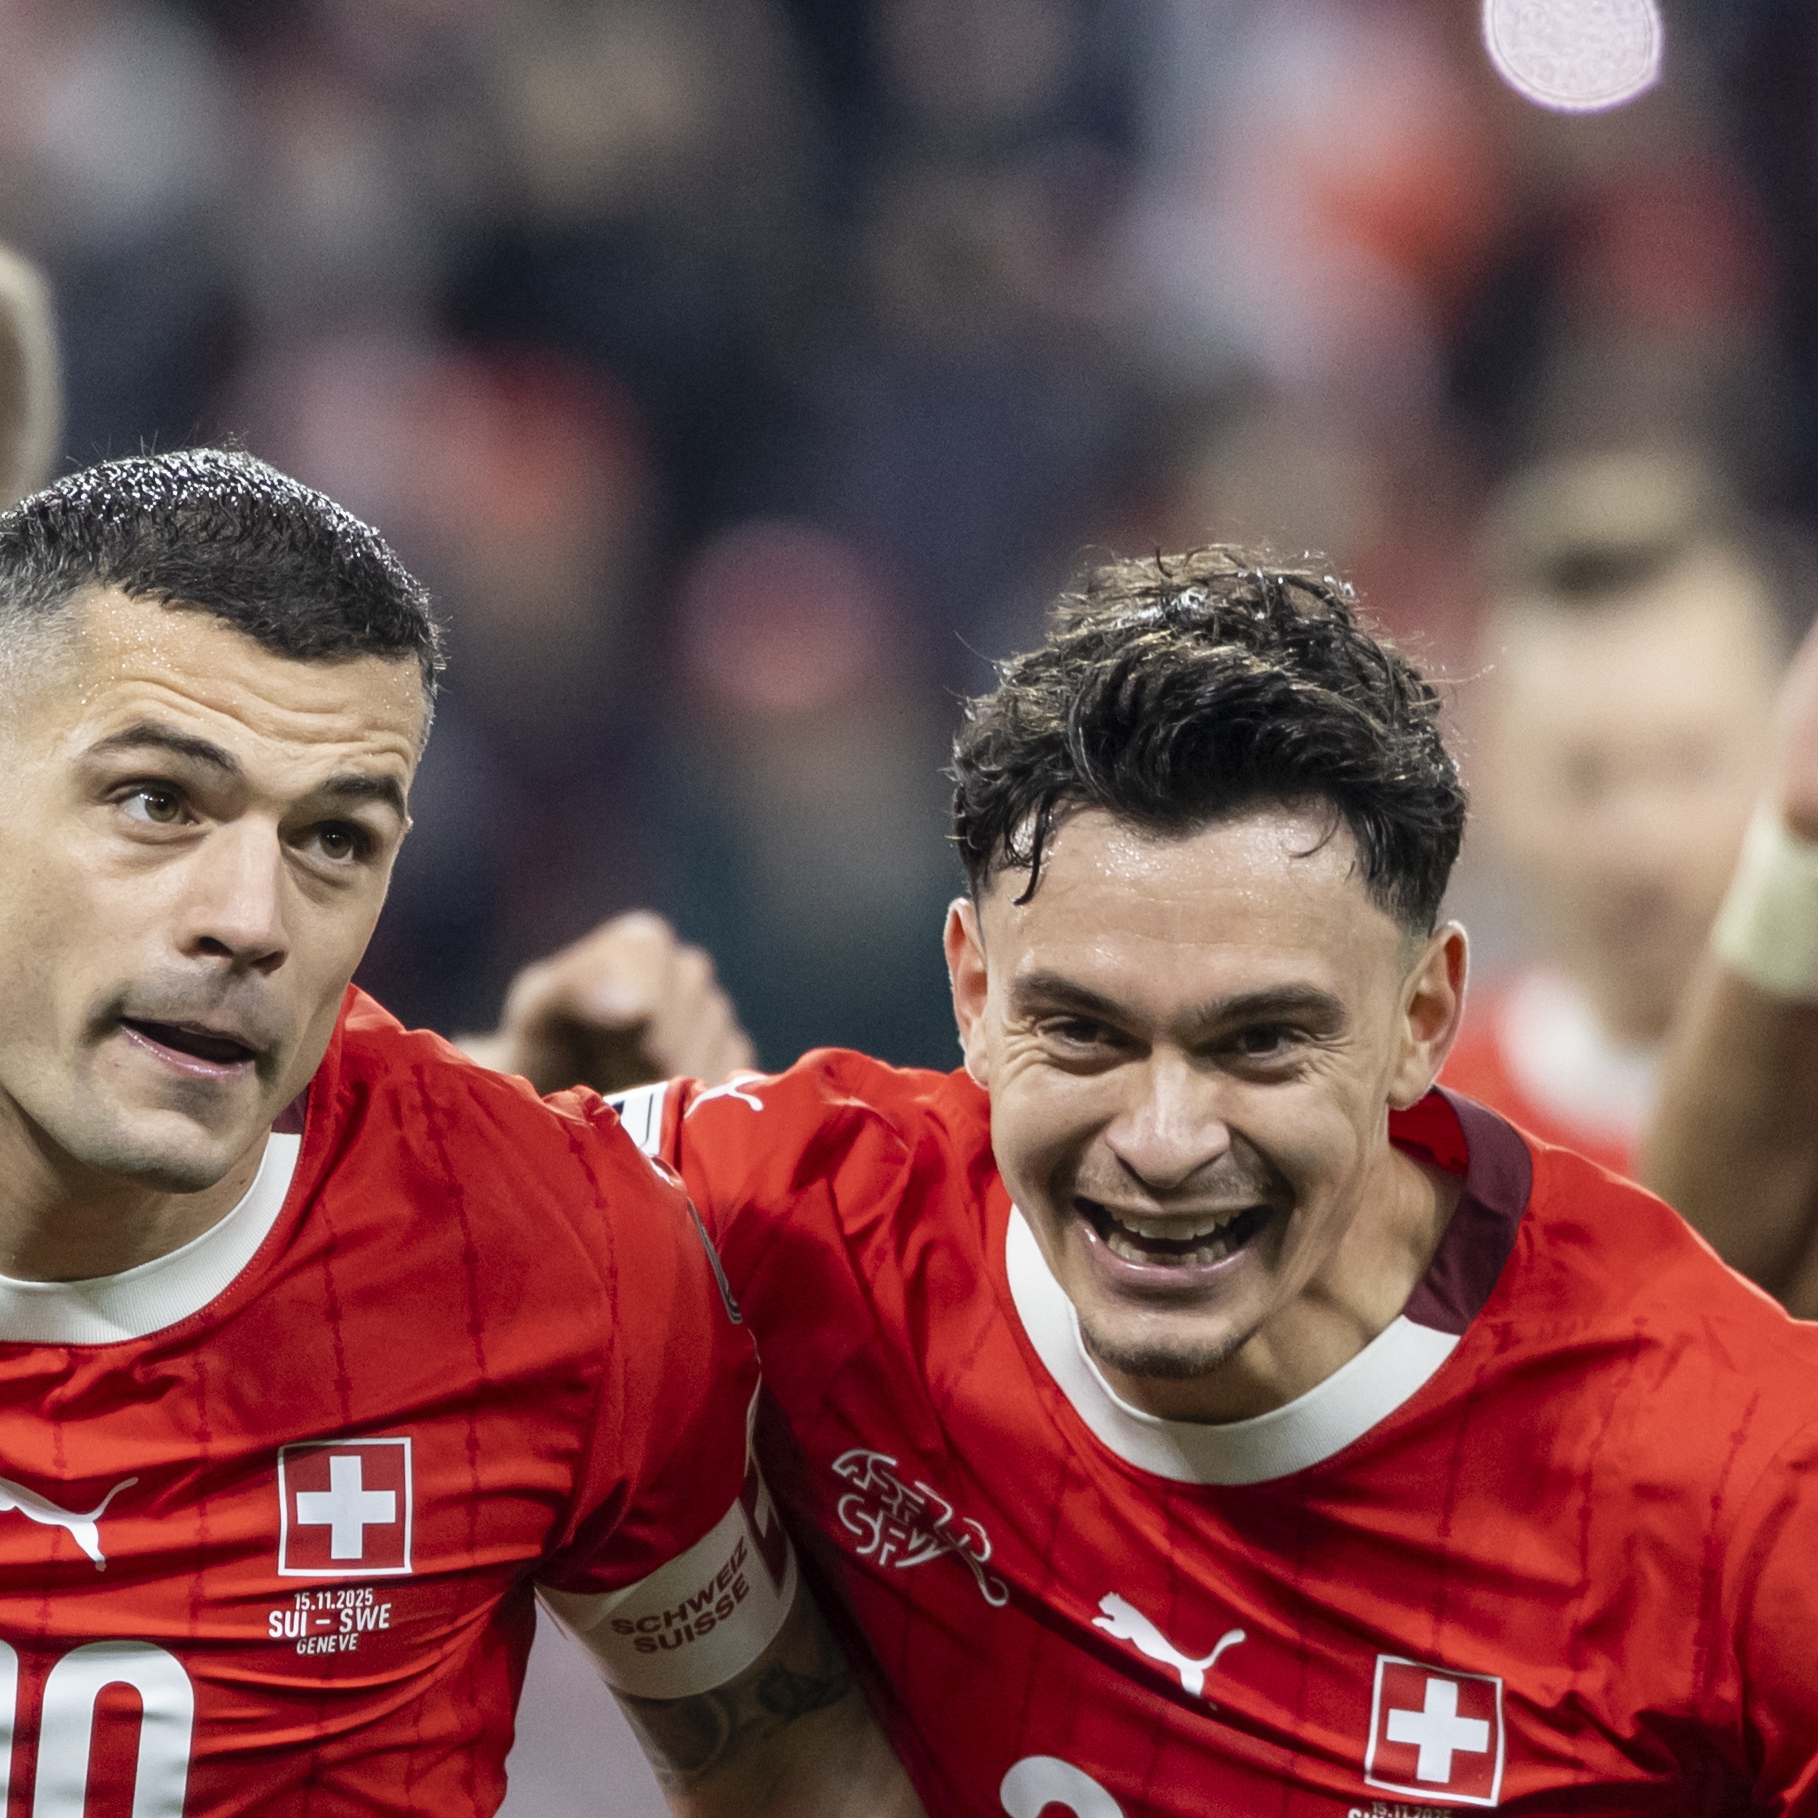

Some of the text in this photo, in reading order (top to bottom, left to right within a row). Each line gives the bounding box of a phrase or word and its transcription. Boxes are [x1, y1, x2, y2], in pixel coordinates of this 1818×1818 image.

[294, 1588, 374, 1612] 15.11.2025
[611, 1535, 748, 1636] SCHWEIZ
[268, 1610, 308, 1638] SUI
[339, 1603, 392, 1633] SWE
[634, 1572, 751, 1654] SUISSE
[296, 1632, 359, 1655] GENEVE
